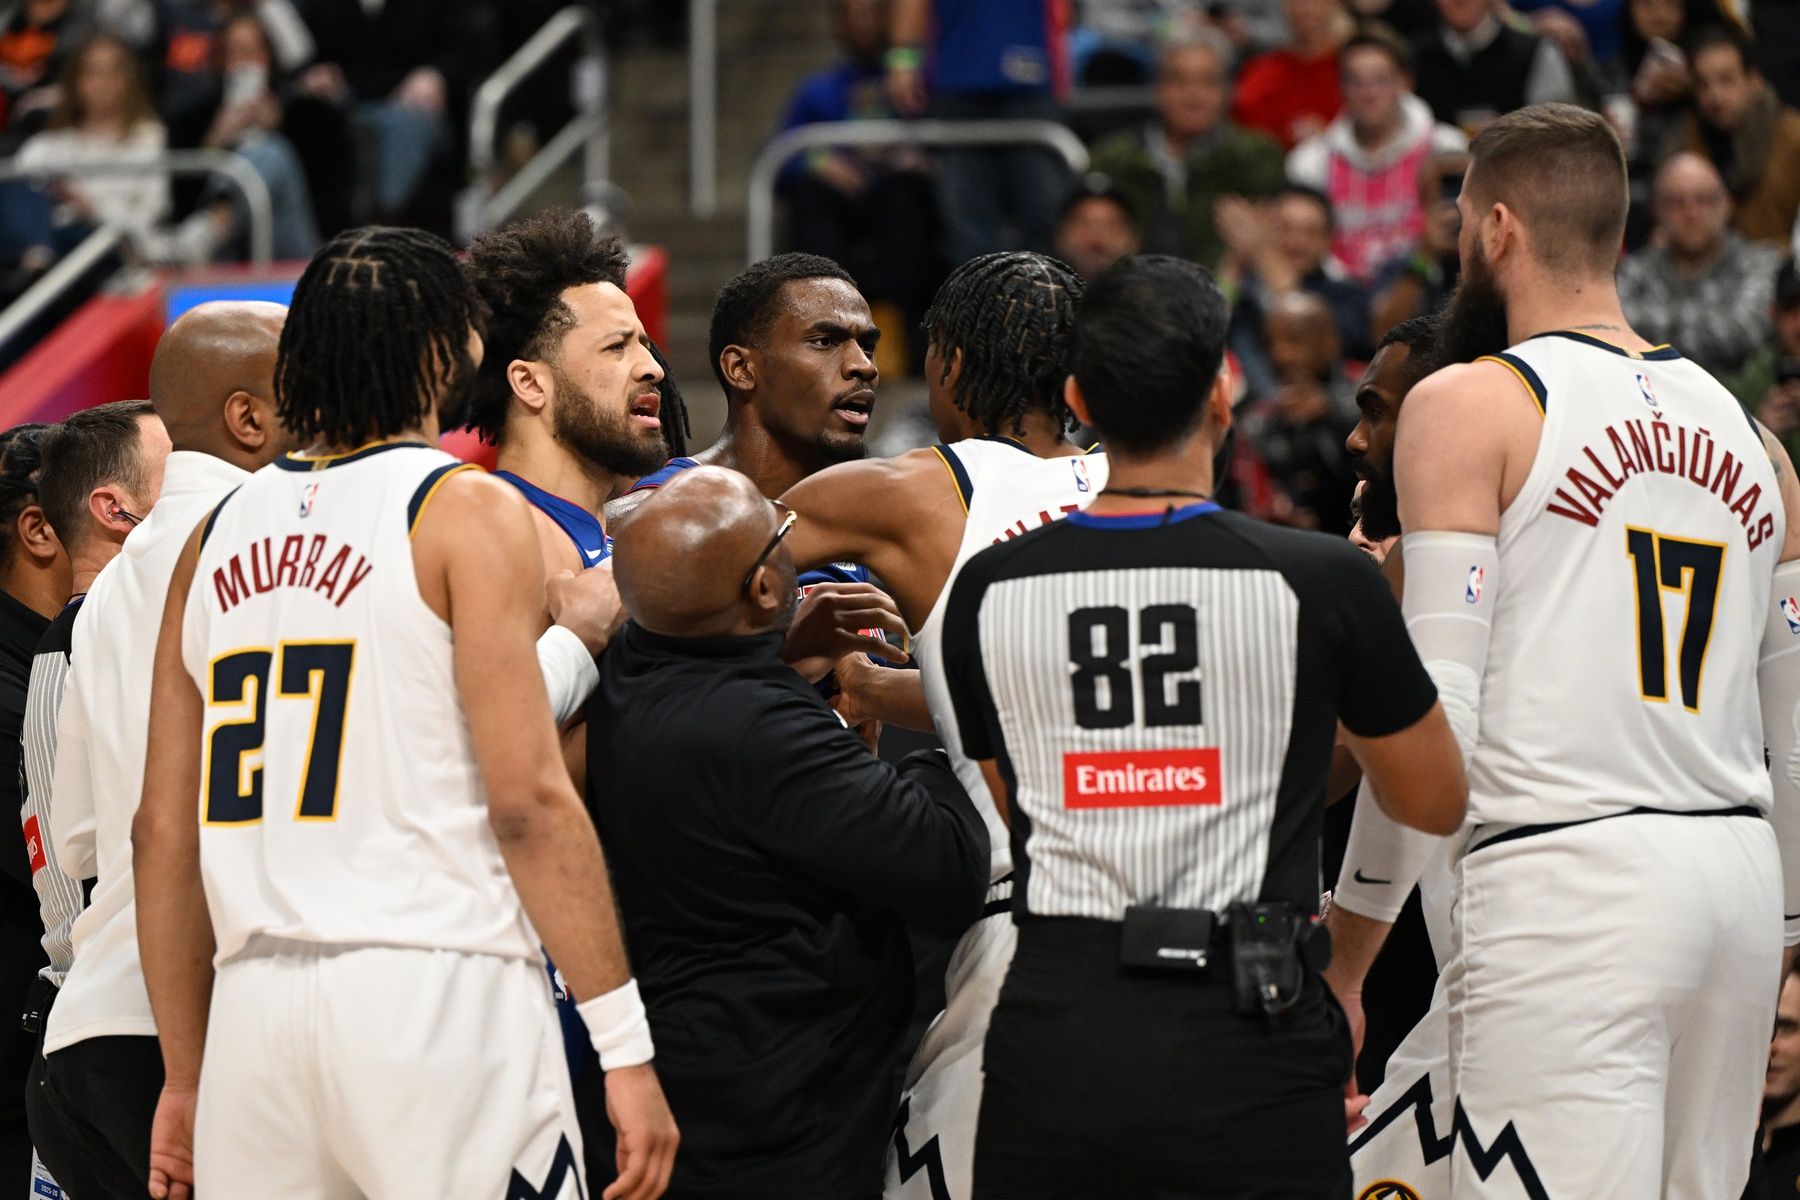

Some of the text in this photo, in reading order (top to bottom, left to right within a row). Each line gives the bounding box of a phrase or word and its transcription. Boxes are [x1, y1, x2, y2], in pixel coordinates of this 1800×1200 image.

[1546, 411, 1774, 552] VALANČIŪNAS
[213, 534, 373, 613] MURRAY
[1625, 524, 1728, 715] 17
[203, 638, 357, 826] 27
[1069, 604, 1201, 729] 82
[1076, 763, 1207, 795] Emirates
